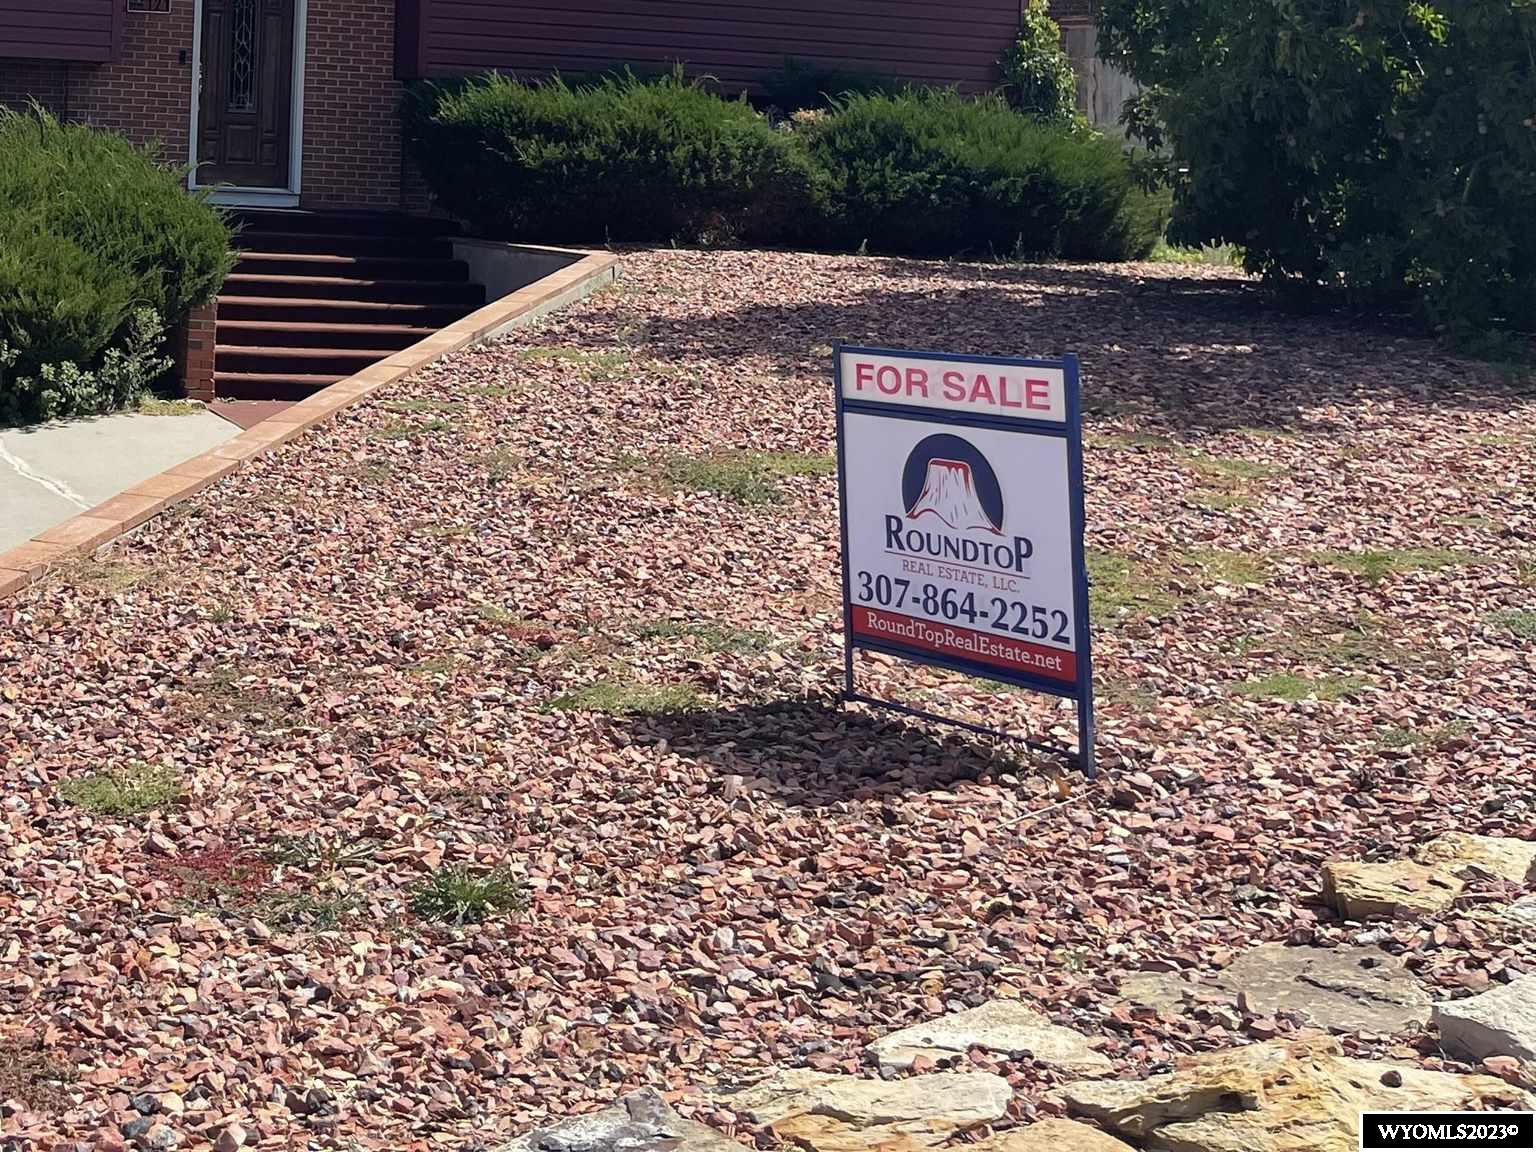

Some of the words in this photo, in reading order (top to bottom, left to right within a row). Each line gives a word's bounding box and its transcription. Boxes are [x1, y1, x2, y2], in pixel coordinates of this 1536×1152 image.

[855, 363, 929, 398] FOR
[942, 371, 1051, 411] SALE
[884, 514, 1033, 573] ROUNDTOP
[902, 559, 934, 577] REAL
[937, 565, 989, 589] ESTATE,
[992, 576, 1021, 593] LLC.
[857, 570, 1071, 645] 307-864-2252
[866, 611, 1062, 672] RoundTopRealEstate.net
